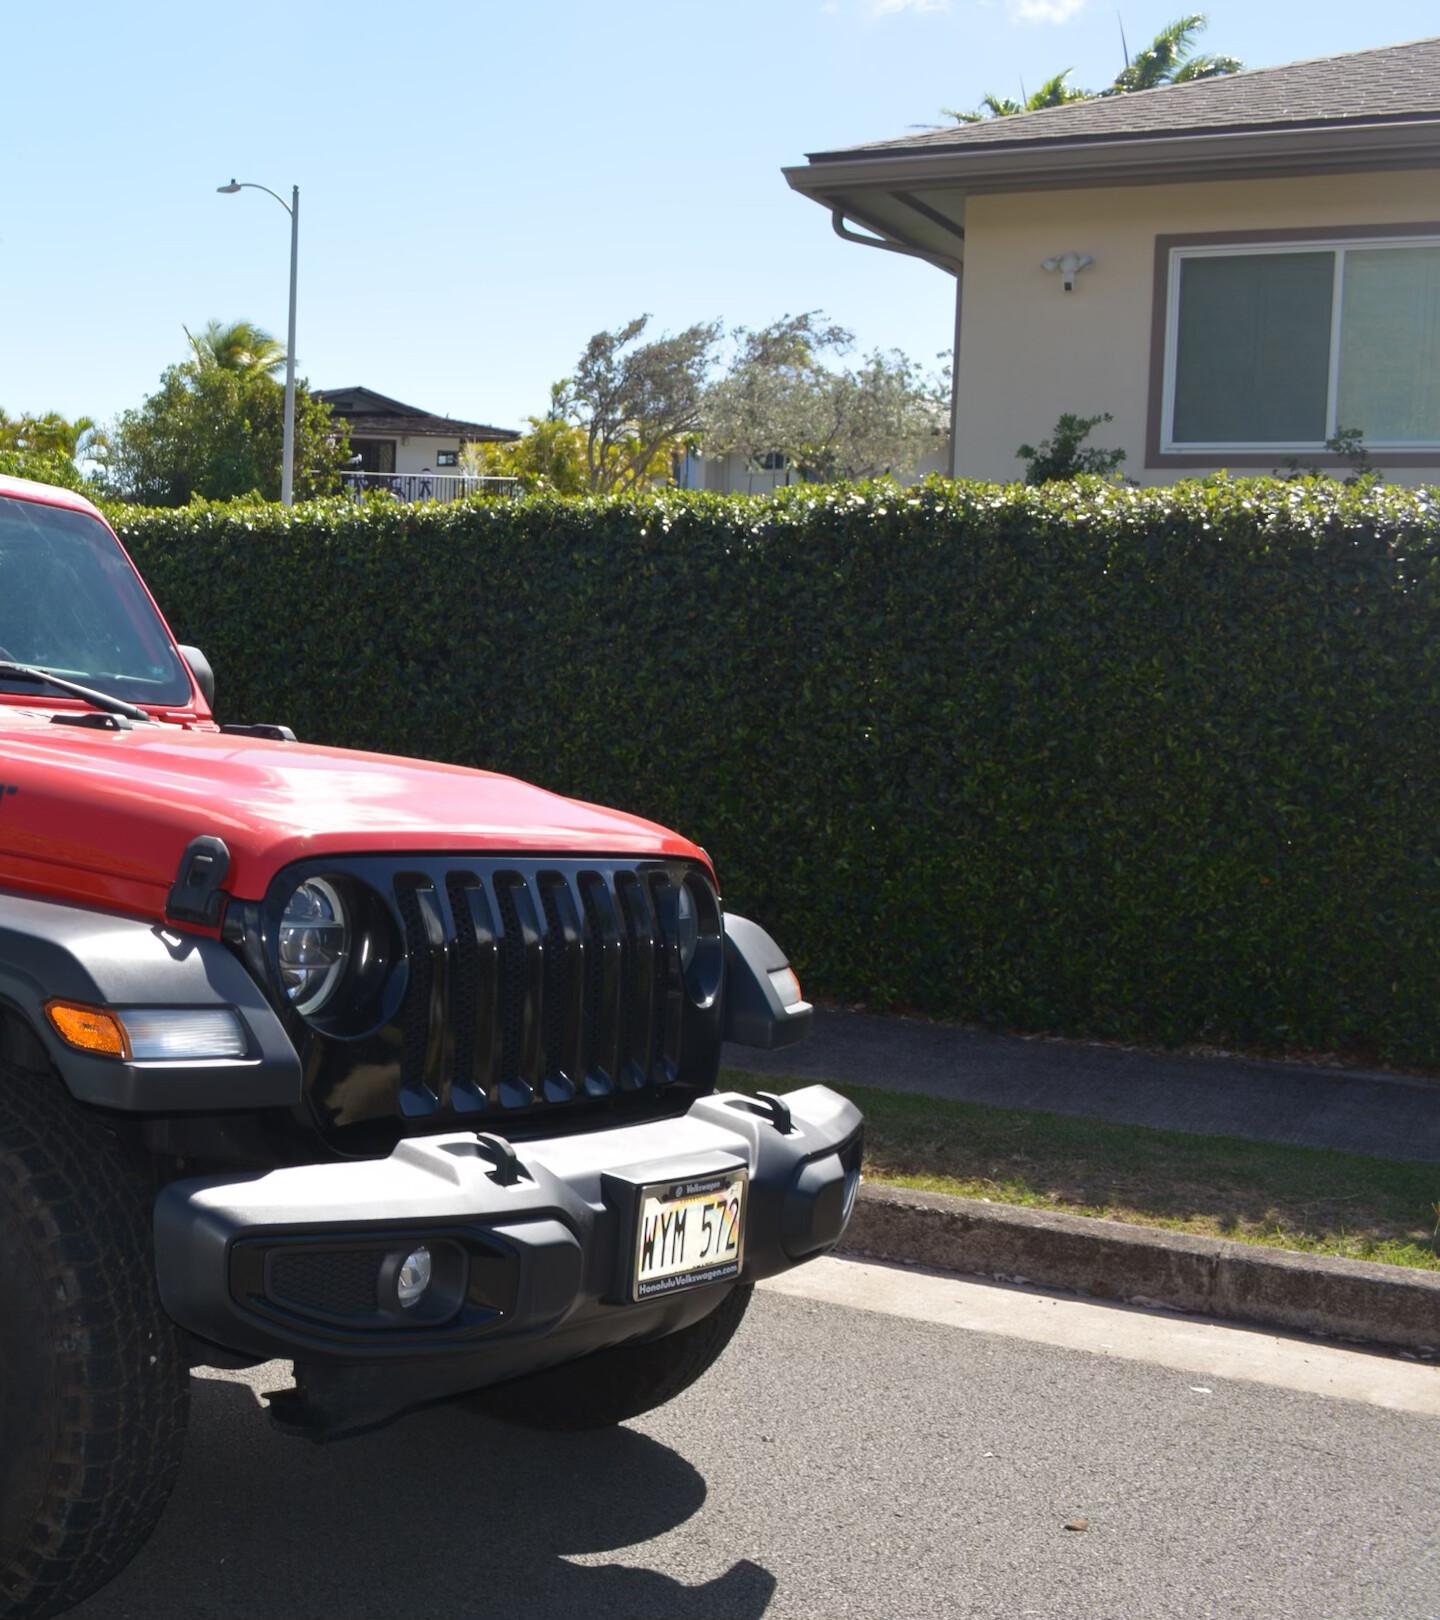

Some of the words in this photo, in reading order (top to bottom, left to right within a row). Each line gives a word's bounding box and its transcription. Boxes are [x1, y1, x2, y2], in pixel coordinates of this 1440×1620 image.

[686, 1181, 721, 1195] Volkswagen
[641, 1208, 688, 1273] WYM
[699, 1197, 739, 1258] 572
